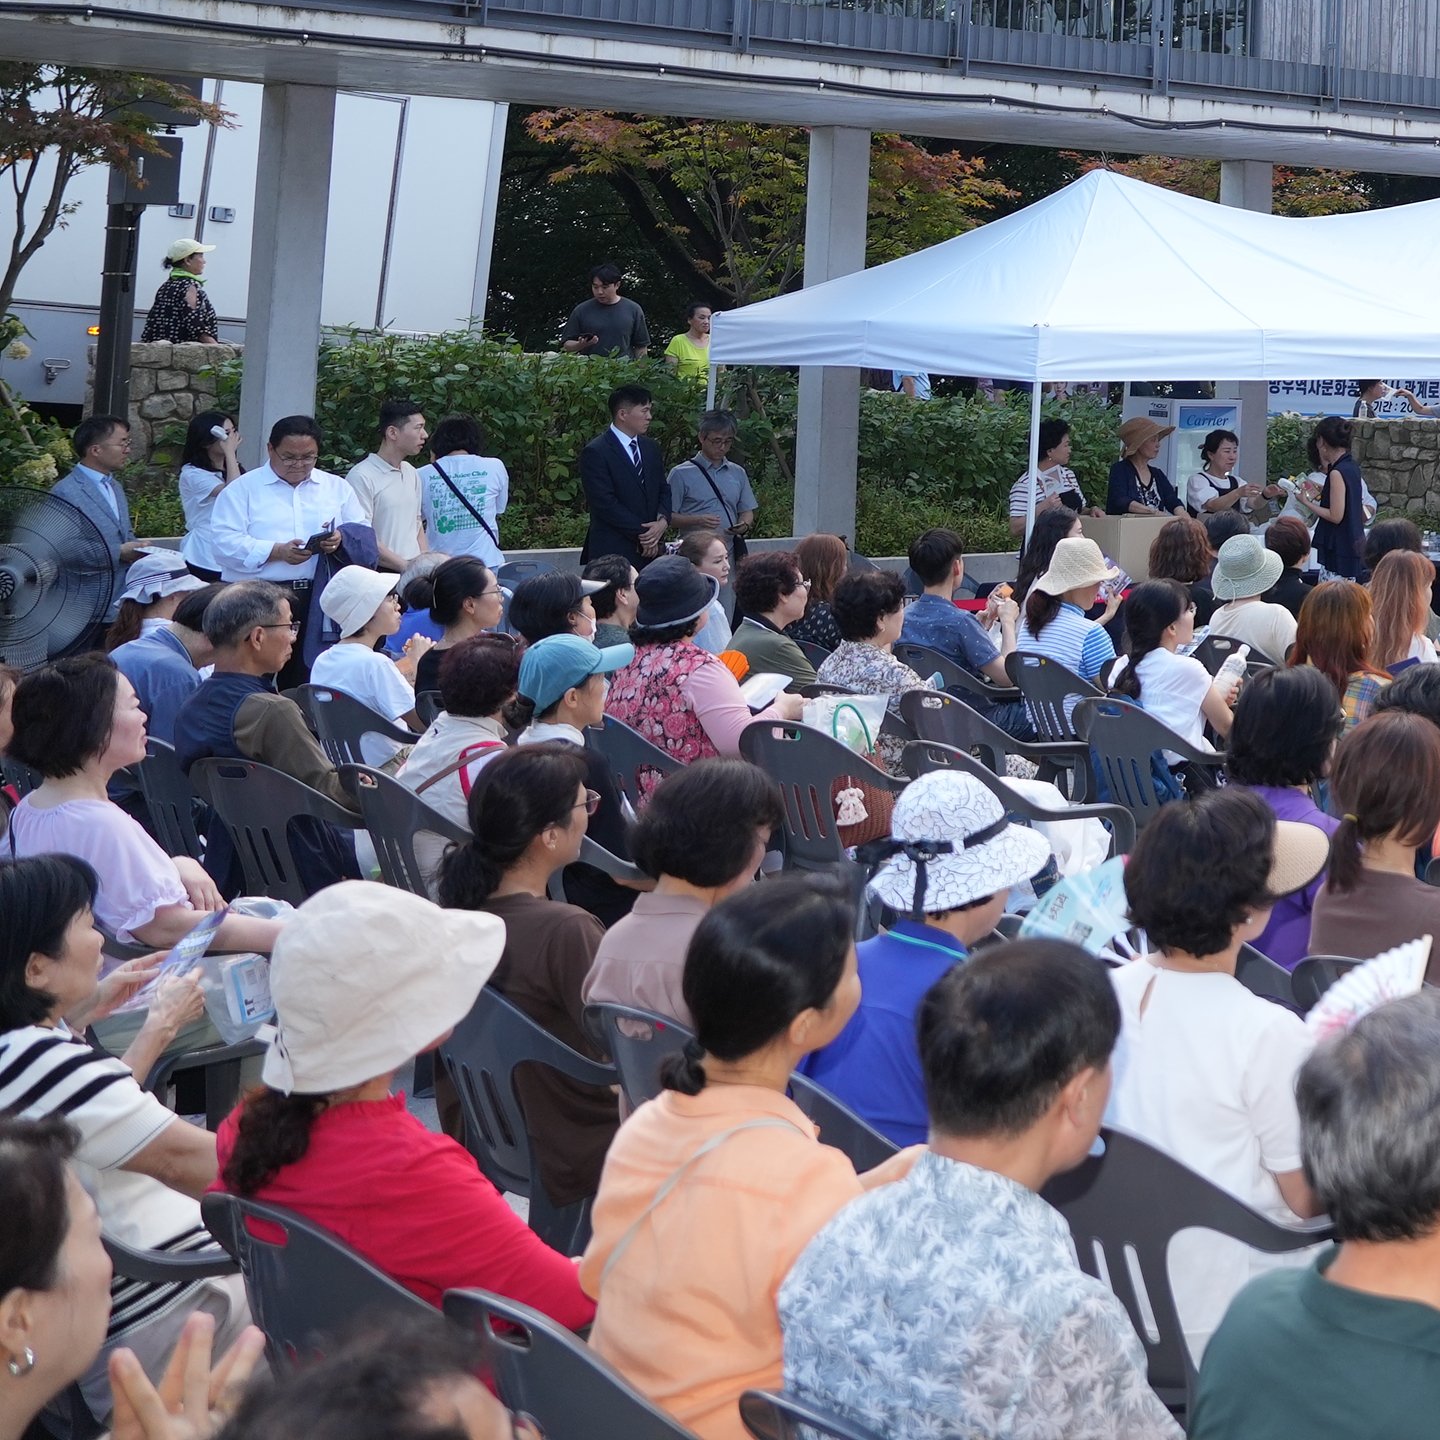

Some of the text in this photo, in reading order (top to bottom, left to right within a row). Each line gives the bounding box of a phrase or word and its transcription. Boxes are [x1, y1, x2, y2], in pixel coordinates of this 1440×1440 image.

[1404, 380, 1440, 399] 관계로
[1373, 401, 1392, 413] 기간
[1186, 414, 1230, 427] Carrier
